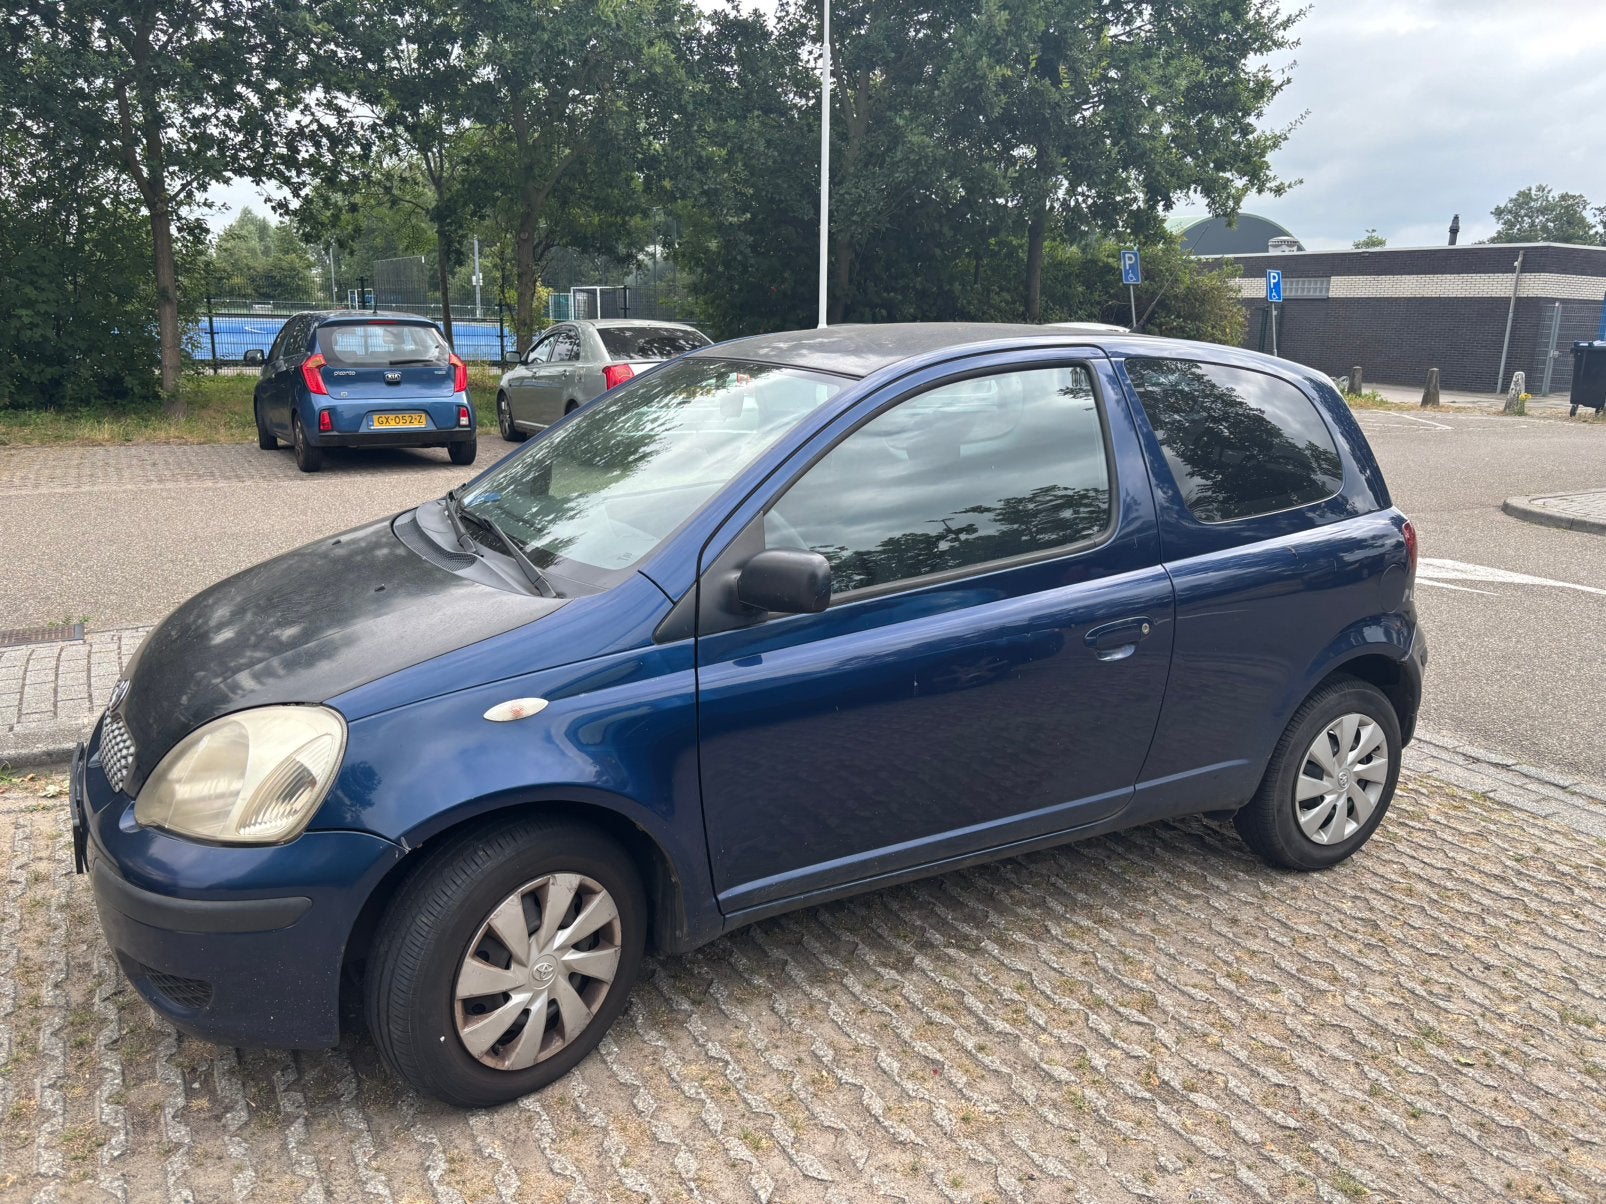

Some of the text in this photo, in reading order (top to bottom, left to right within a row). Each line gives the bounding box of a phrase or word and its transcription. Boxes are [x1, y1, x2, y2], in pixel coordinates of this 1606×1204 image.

[1125, 253, 1135, 270] P
[1270, 272, 1278, 288] P
[377, 415, 423, 425] GX-052-Z
